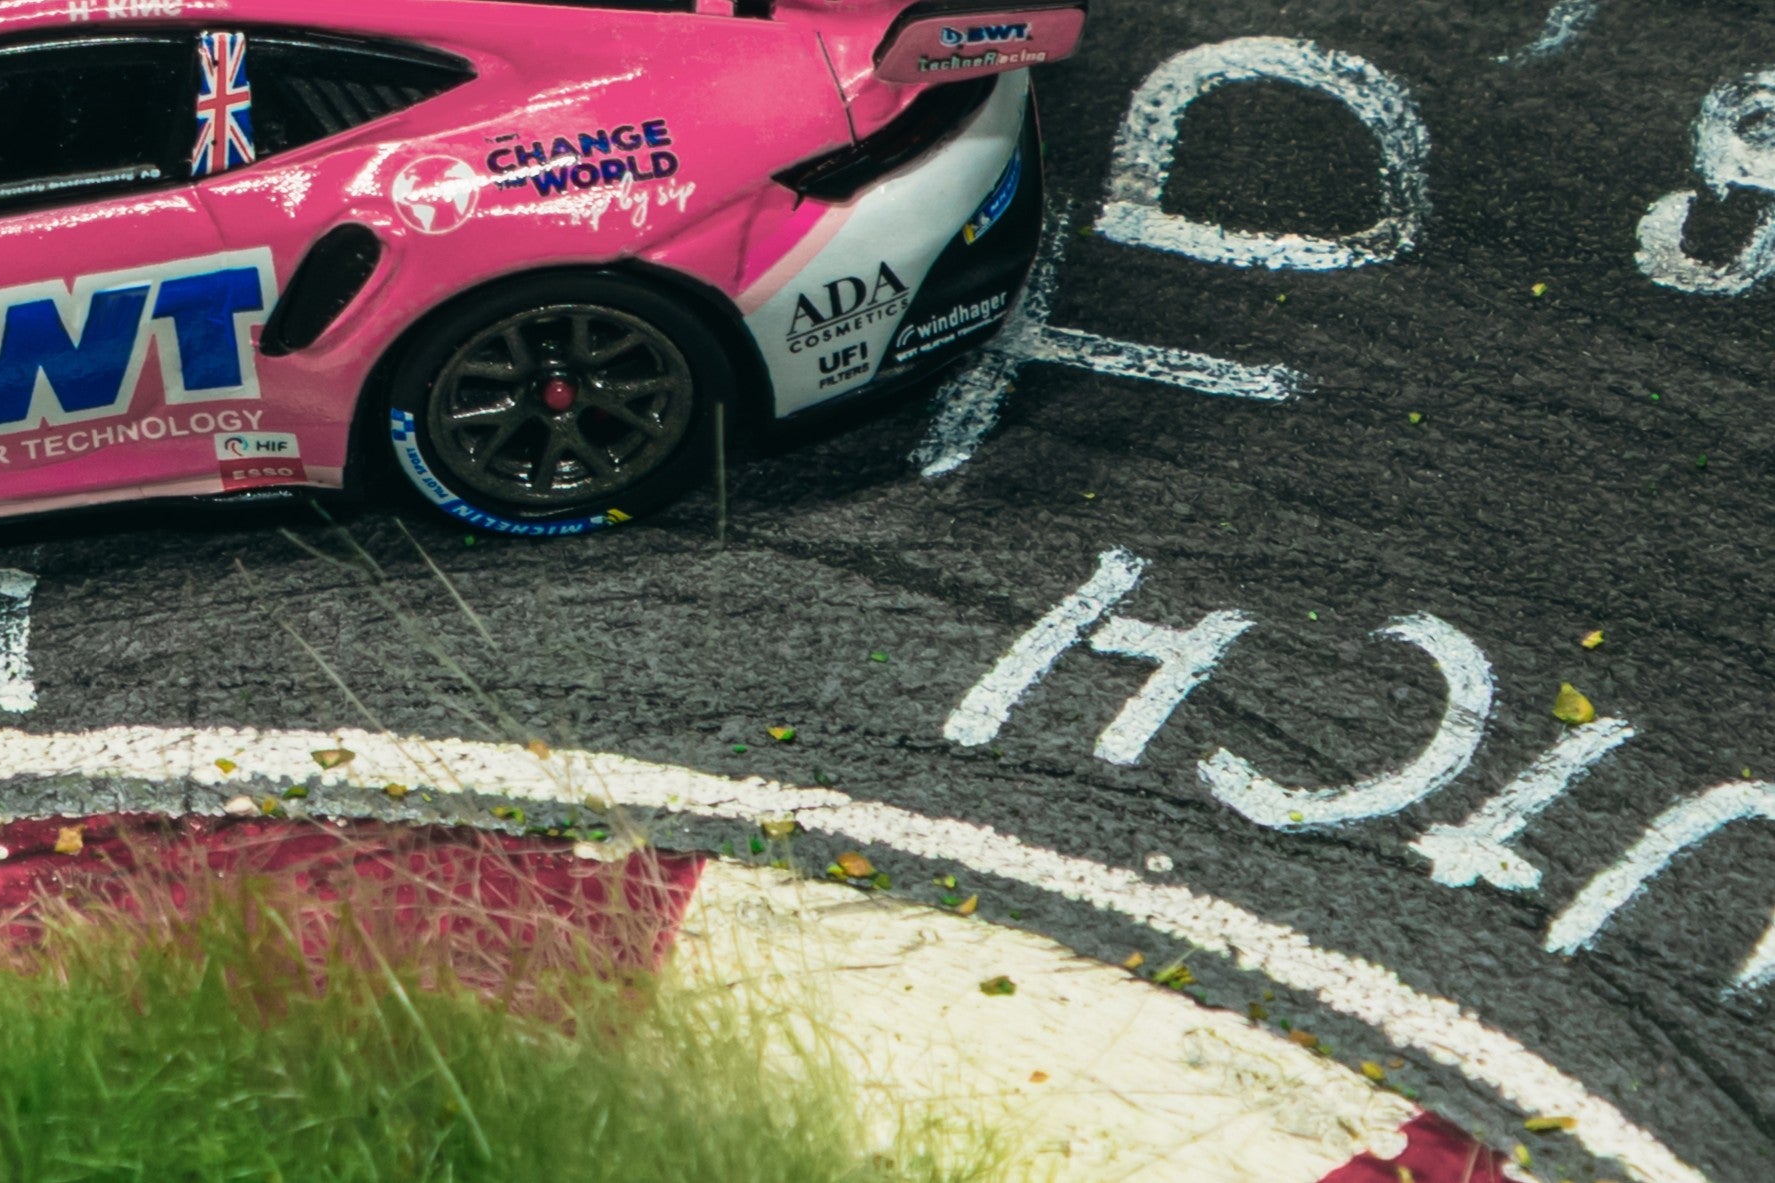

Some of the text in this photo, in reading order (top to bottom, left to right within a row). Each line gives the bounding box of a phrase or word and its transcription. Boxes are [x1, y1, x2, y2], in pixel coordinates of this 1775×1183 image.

[967, 23, 1027, 41] BWT
[484, 119, 673, 176] CHANGE
[532, 150, 681, 198] WORLD
[786, 260, 909, 342] ADA
[916, 288, 1008, 340] windhager
[789, 297, 909, 354] COSMETICS
[819, 342, 869, 375] UFI
[819, 363, 870, 389] FILTERS
[21, 409, 265, 460] TECHNOLOGY
[257, 440, 288, 452] HIF
[232, 468, 293, 490] ESSO
[451, 504, 582, 536] MICHELIN
